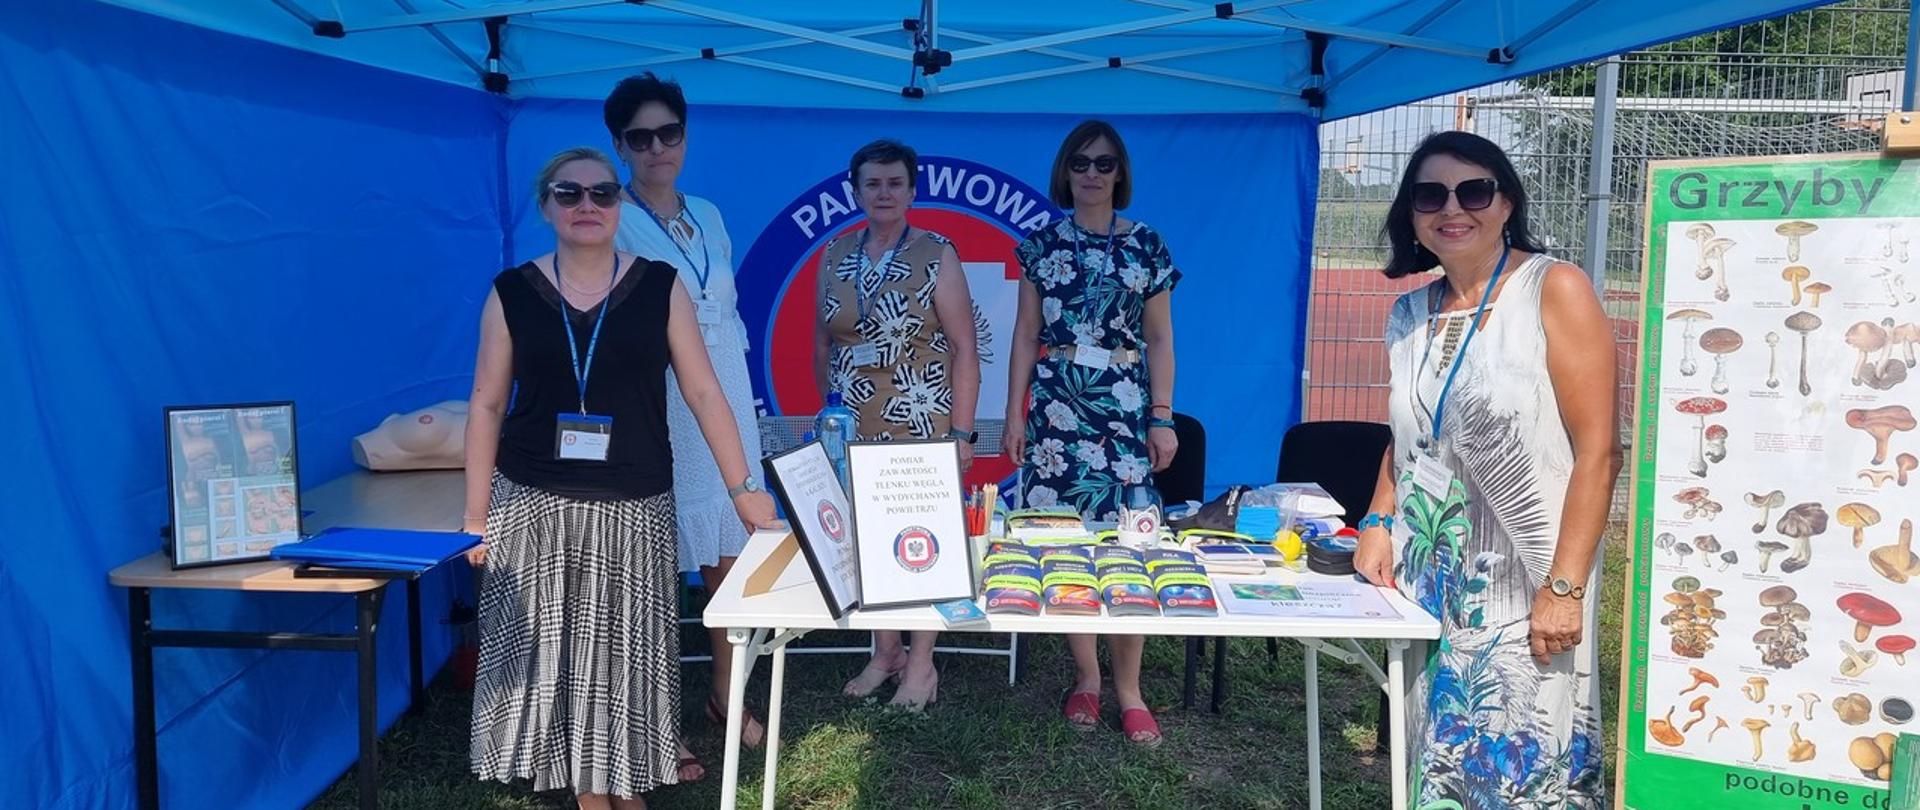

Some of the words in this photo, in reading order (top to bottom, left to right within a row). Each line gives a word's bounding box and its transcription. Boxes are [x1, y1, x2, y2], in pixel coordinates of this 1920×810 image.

[1669, 168, 1885, 216] Grzyby
[791, 164, 1051, 240] PAWOWA
[889, 456, 924, 465] POMIAR
[879, 466, 937, 477] ZAWARTOŚCI
[875, 480, 910, 490] TLENKU
[912, 479, 945, 489] WĘGLA
[872, 494, 880, 502] W
[882, 491, 950, 502] WYDYCHANYM
[886, 504, 938, 515] POWIETRZU
[1726, 772, 1850, 805] podobne
